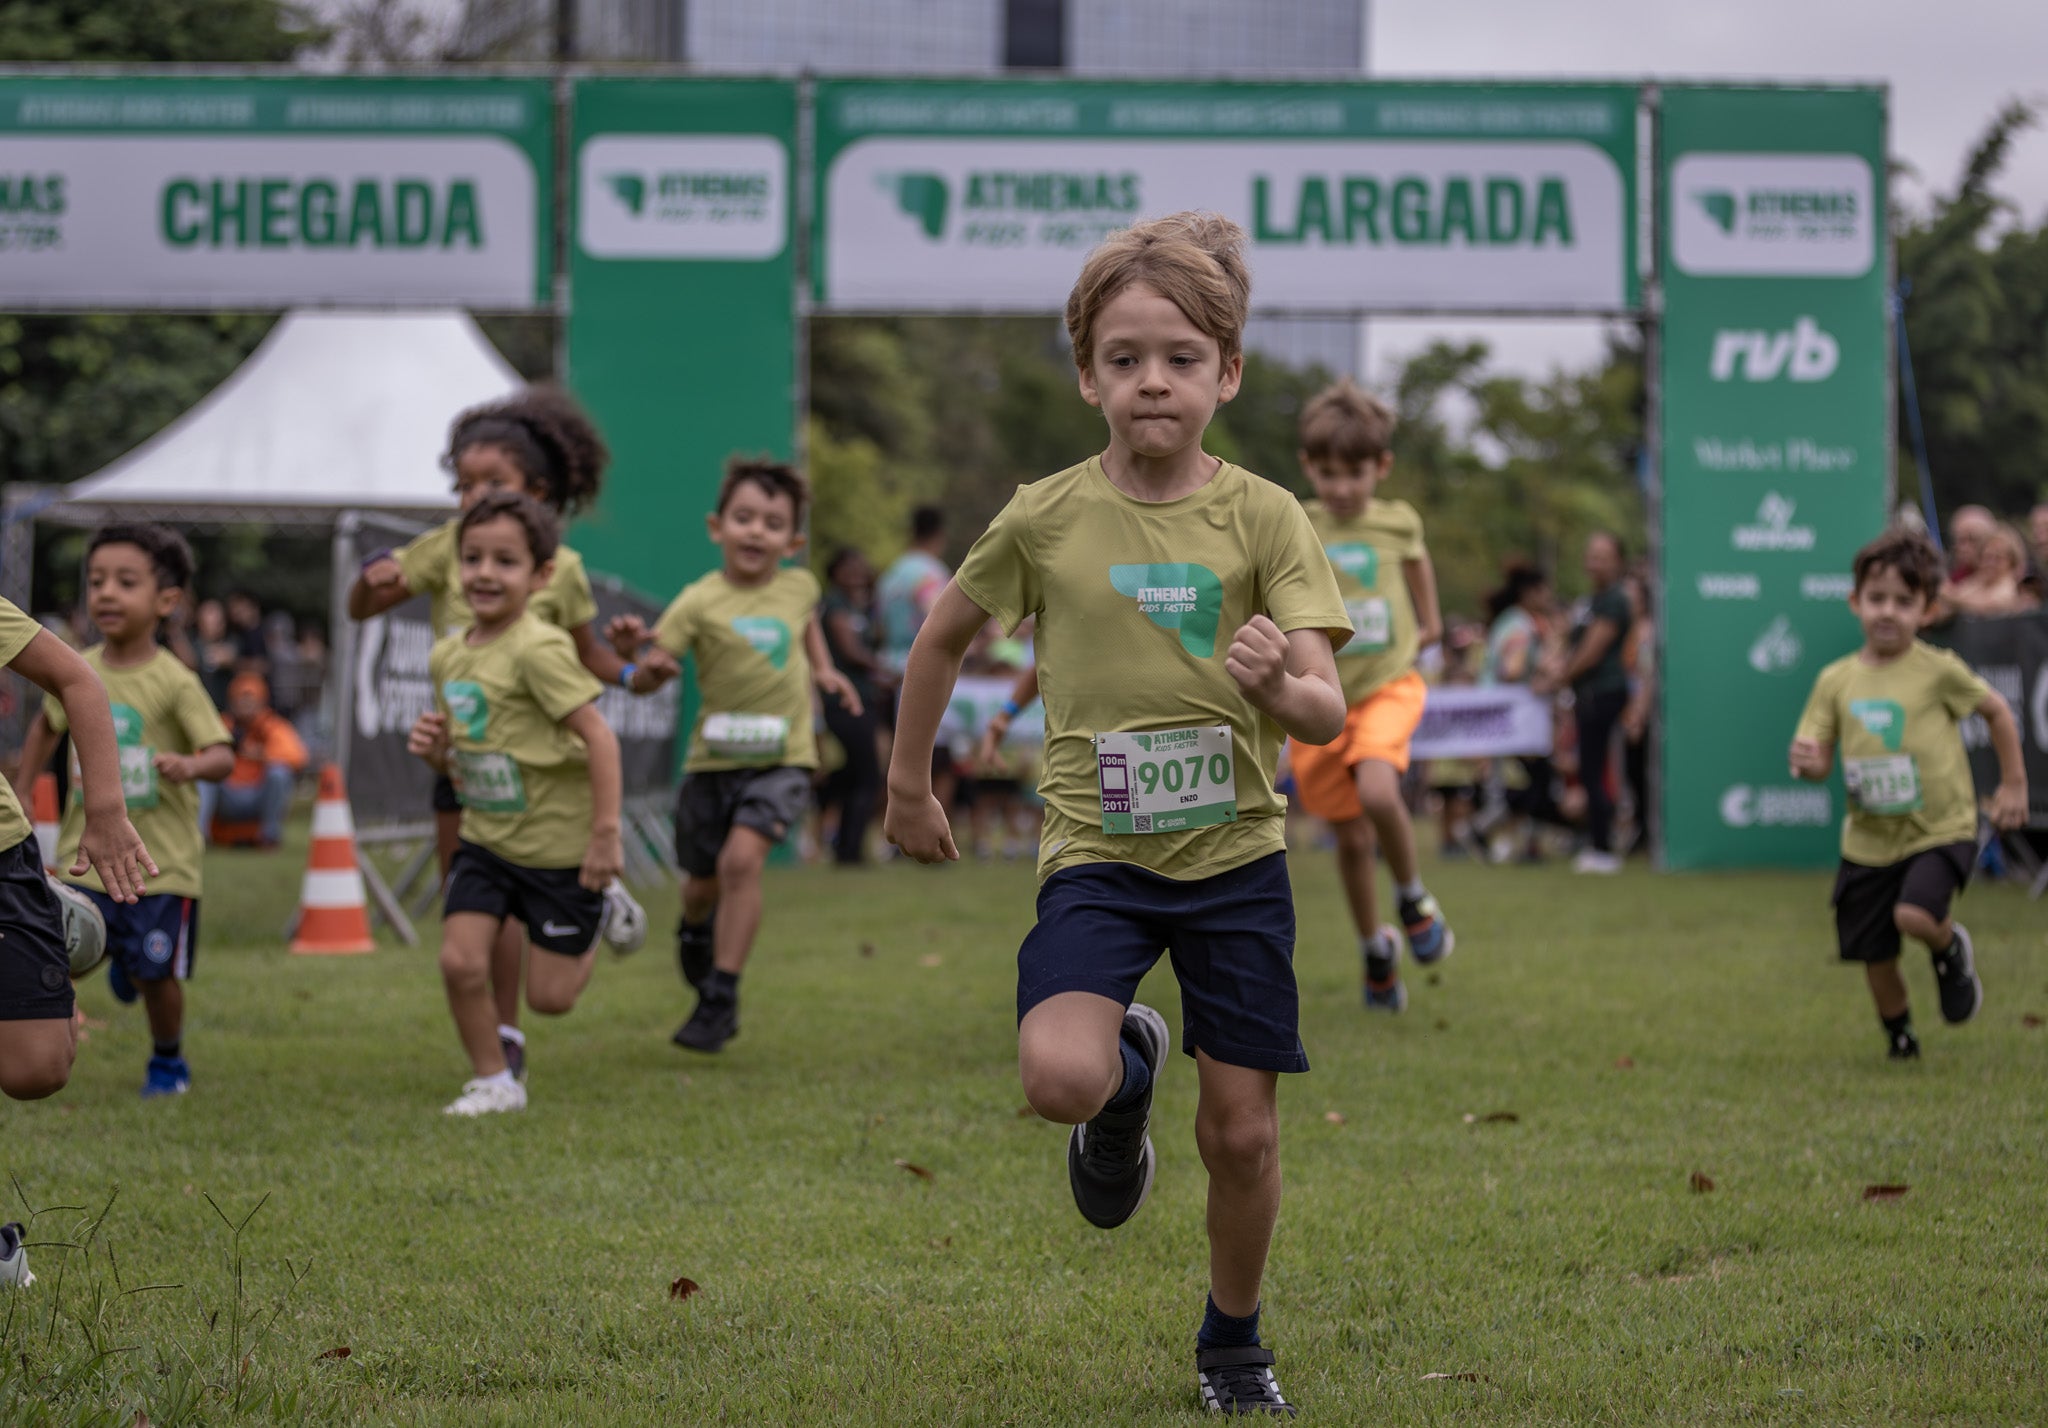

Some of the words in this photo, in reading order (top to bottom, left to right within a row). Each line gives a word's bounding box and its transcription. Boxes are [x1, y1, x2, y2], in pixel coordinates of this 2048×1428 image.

[964, 168, 1142, 212] ATHENAS
[160, 174, 486, 252] CHEGADA
[1250, 172, 1575, 248] LARGADA
[1709, 314, 1841, 384] rvb
[1137, 587, 1197, 602] ATHENAS
[1138, 603, 1161, 613] KIDS
[1163, 602, 1197, 613] FASTER
[1154, 729, 1199, 744] ATHENAS
[1154, 743, 1172, 752] KIDS
[1173, 740, 1199, 750] FASTER
[1100, 756, 1126, 766] 100m
[1138, 753, 1230, 794] 9070
[1103, 801, 1129, 811] 2017
[1180, 794, 1198, 803] ENZO
